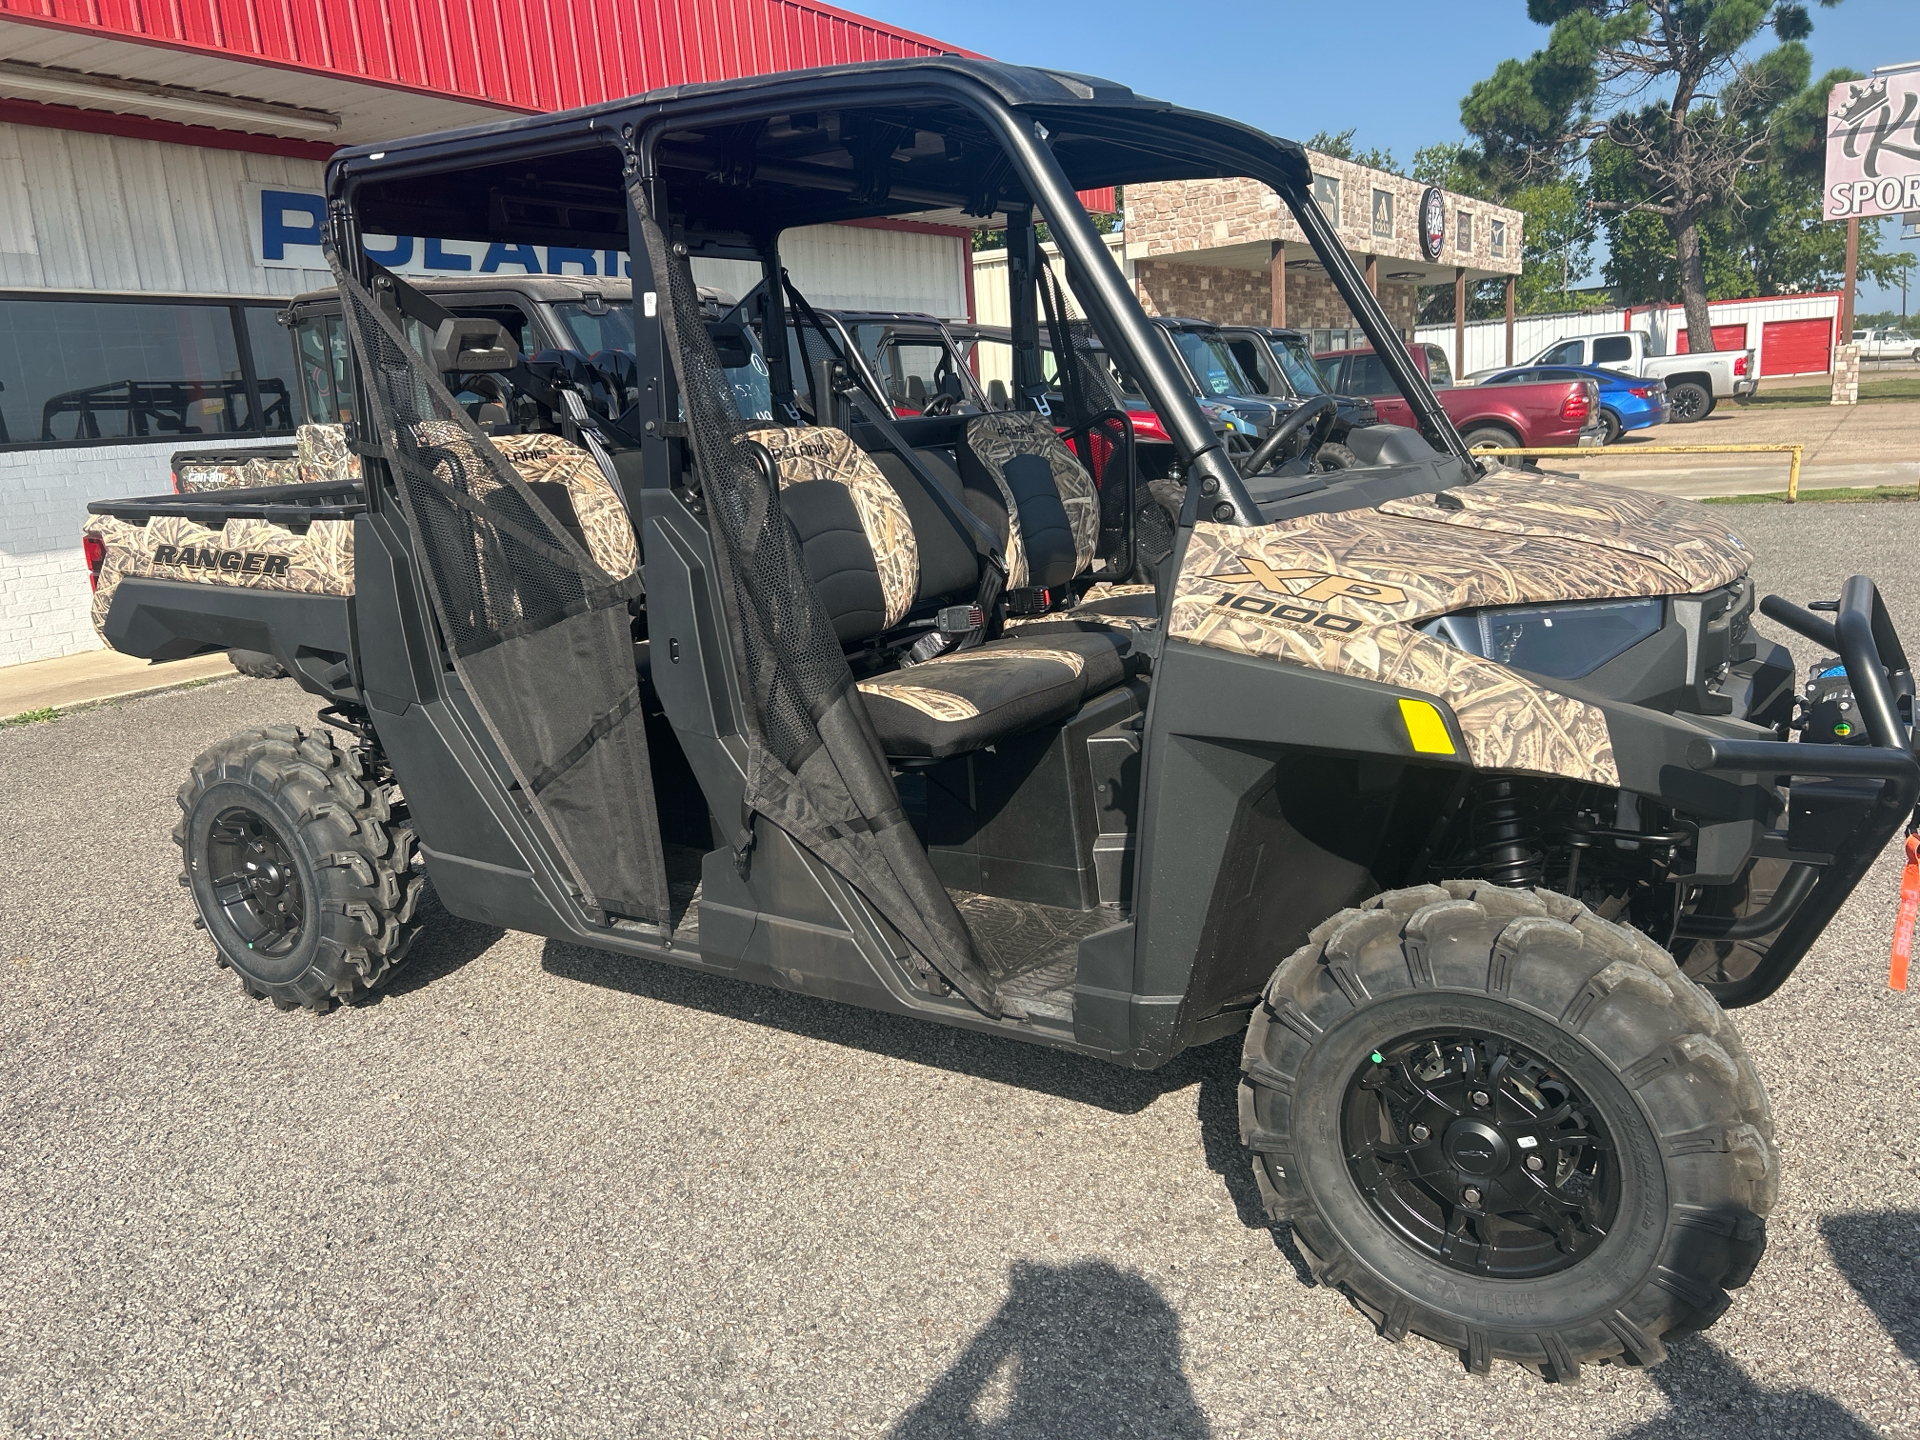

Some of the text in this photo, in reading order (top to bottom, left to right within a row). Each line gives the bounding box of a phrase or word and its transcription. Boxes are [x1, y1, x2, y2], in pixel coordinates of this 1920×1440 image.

[462, 355, 507, 363] RANGER
[997, 424, 1035, 437] POLARIS
[505, 449, 548, 462] LARIS
[770, 443, 829, 459] POLARIS
[188, 472, 225, 482] can-am
[153, 544, 290, 577] RANGER
[1195, 556, 1409, 605] XP
[1215, 592, 1364, 633] 1000
[1895, 889, 1918, 958] POLARIS
[1372, 1006, 1550, 1048] PRO ARMOR
[1476, 1290, 1538, 1315] MUD
